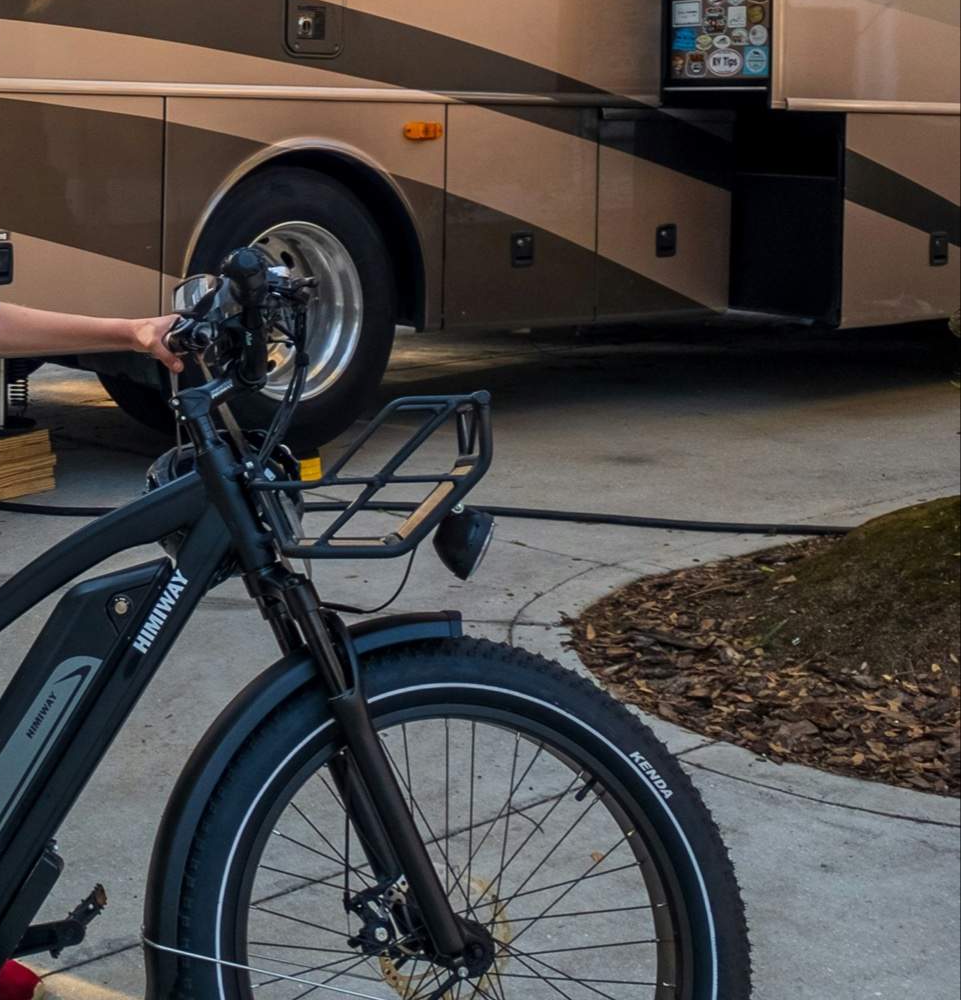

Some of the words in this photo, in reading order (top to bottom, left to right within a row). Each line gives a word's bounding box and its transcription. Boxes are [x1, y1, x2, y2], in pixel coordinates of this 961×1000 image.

[132, 568, 189, 654] HIMIWAY
[26, 691, 58, 739] HIMIWAY
[629, 751, 674, 799] KENDA
